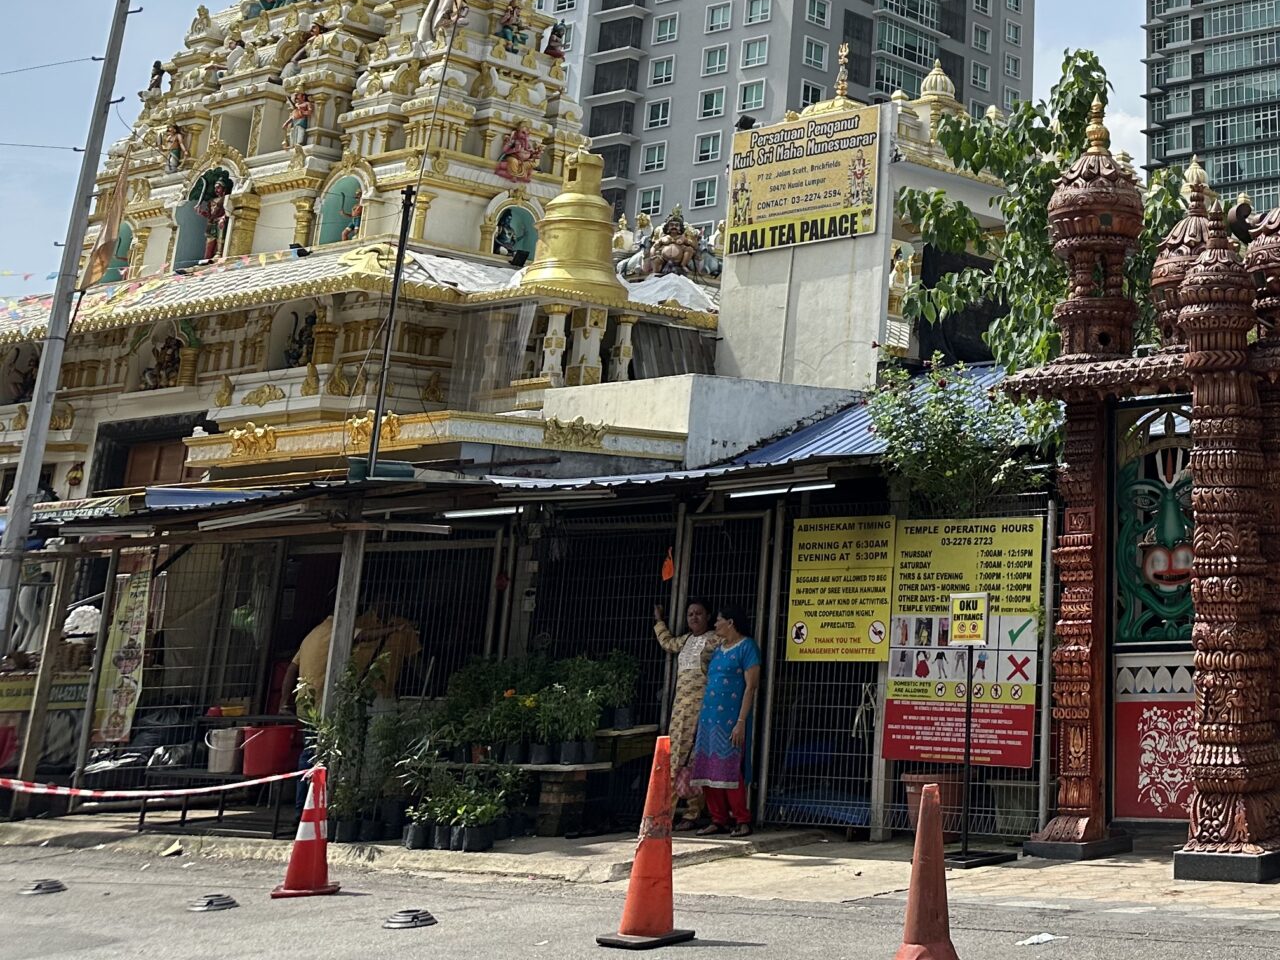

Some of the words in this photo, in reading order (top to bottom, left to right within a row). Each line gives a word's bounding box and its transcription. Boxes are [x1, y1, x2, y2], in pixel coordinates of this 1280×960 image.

[750, 126, 805, 148] Persatuan
[807, 115, 860, 138] Penganut
[733, 150, 755, 170] Kuil
[757, 147, 774, 165] Sri
[775, 142, 804, 162] Maha
[806, 132, 877, 156] Muneswarar
[810, 161, 840, 172] Brickfields
[769, 183, 786, 192] 50470
[788, 181, 803, 189] Kuala
[805, 178, 826, 188] Lumpur
[791, 191, 821, 205] 03-2274
[824, 189, 841, 199] 2594
[729, 228, 766, 254] RAAJ
[769, 223, 796, 247] TEA
[800, 213, 859, 242] PALACE
[798, 523, 855, 532] ABHISHEKAM
[858, 521, 890, 530] TIMING
[904, 526, 939, 534] TEMPLE
[944, 525, 996, 533] OPERATING
[1002, 524, 1034, 532] HOURS
[799, 541, 839, 550] MORNING
[842, 541, 852, 549] AT
[856, 540, 888, 548] 6:30AM
[974, 537, 993, 545] 2723
[798, 553, 836, 561] EVENING
[856, 552, 887, 560] 5:30PM
[1008, 549, 1033, 557] 12:15PM
[900, 561, 931, 569] SATURDAY
[959, 600, 978, 611] OKU
[954, 613, 983, 621] ENTRANCE
